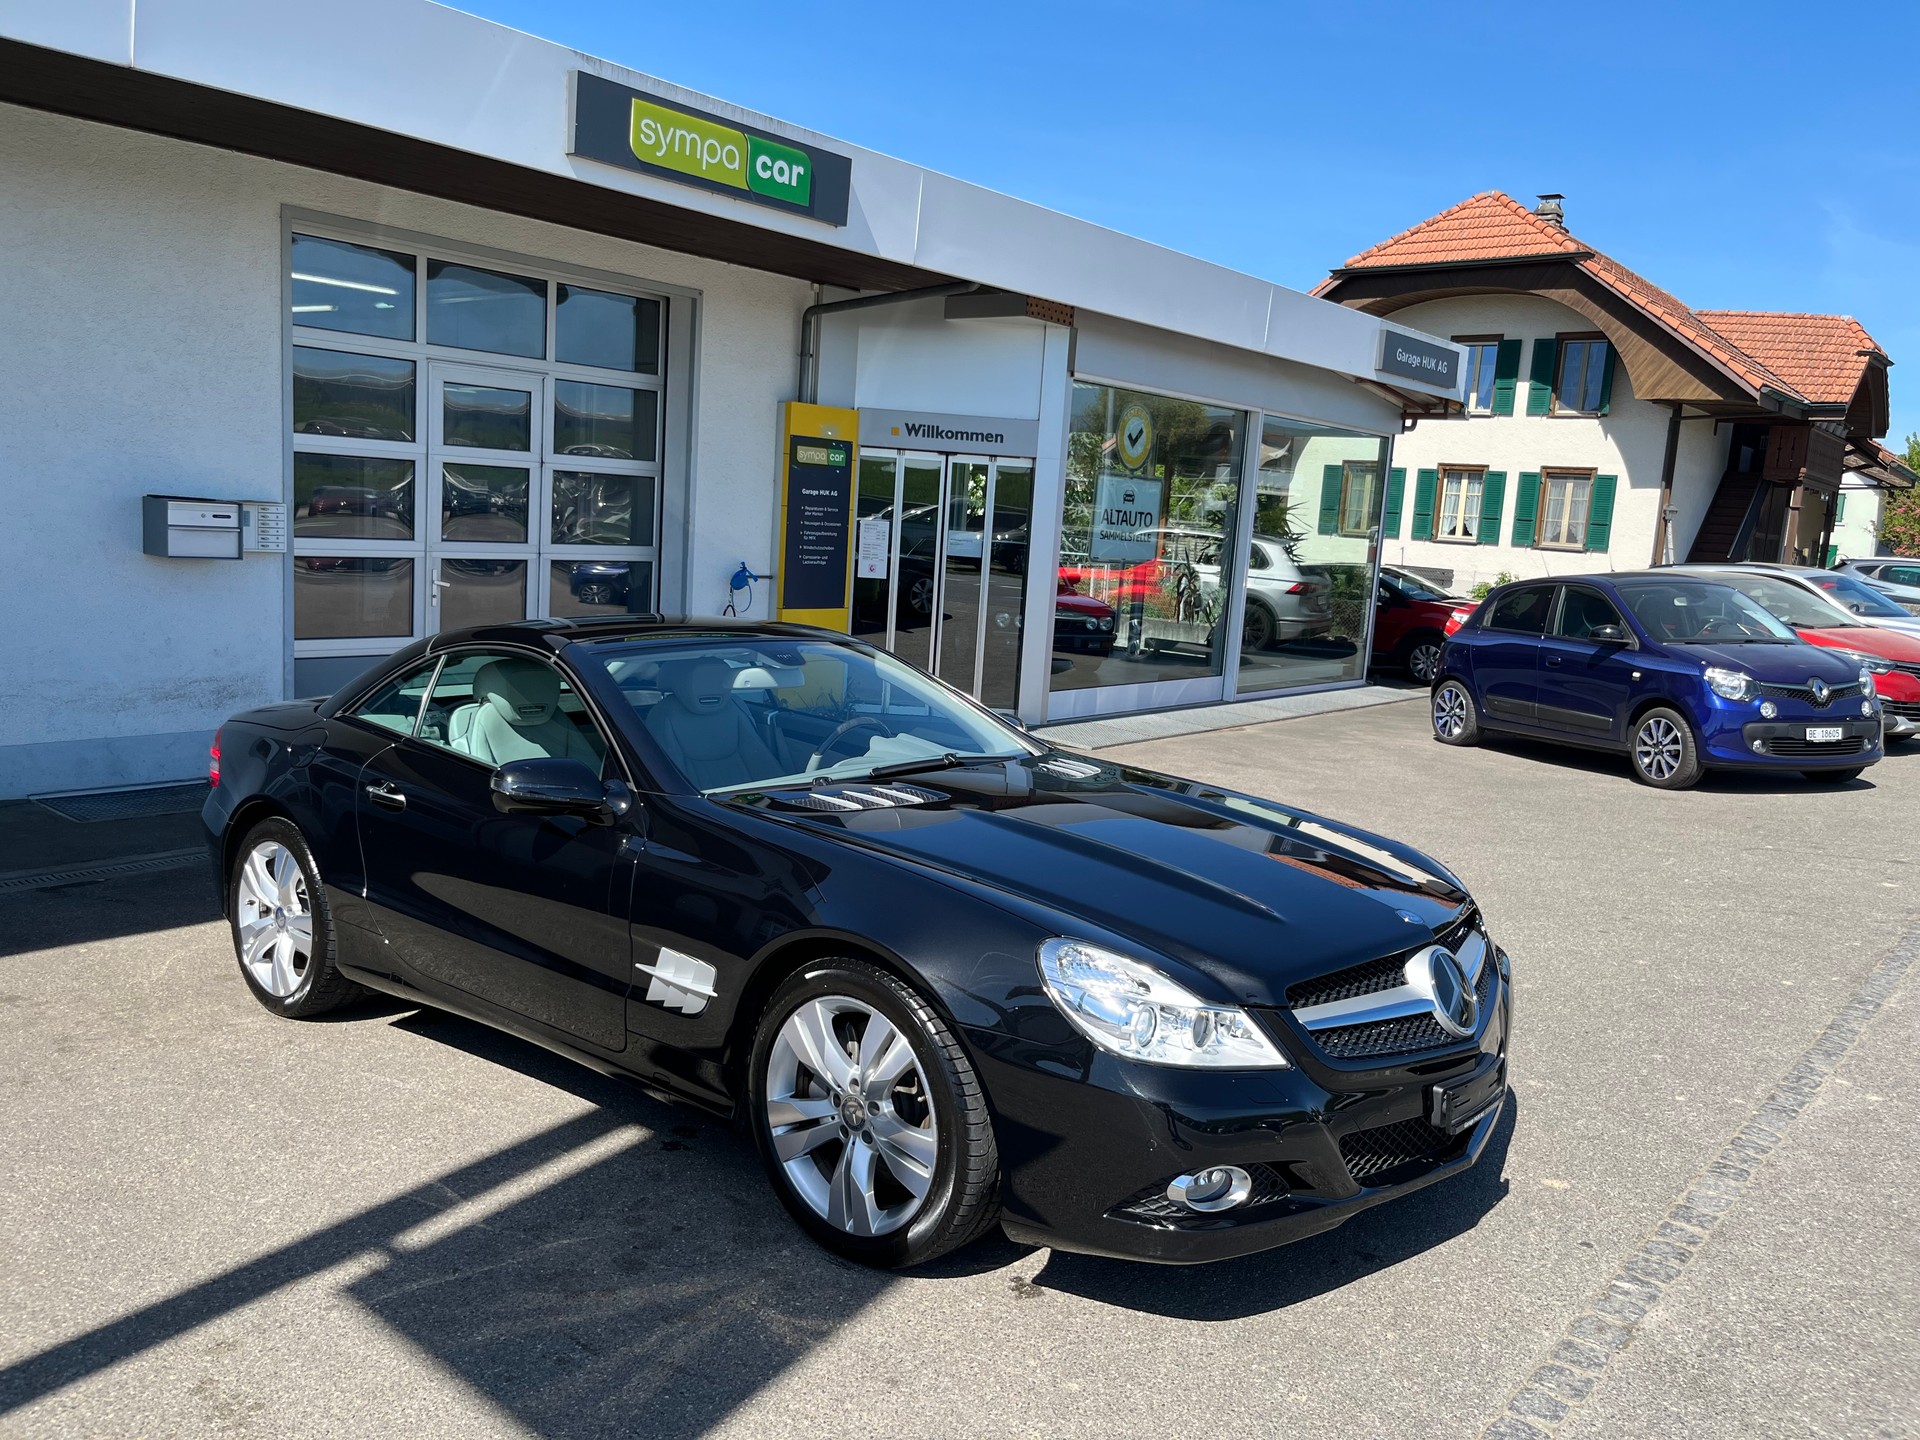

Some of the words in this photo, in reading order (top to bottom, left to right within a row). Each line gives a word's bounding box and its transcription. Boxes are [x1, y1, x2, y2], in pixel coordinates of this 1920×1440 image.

[640, 119, 740, 170] sympa
[755, 155, 804, 187] car
[1396, 348, 1420, 367] Garage
[1422, 356, 1436, 370] HUK
[1437, 361, 1448, 373] AG
[904, 422, 1004, 443] Willkommen
[799, 450, 826, 461] sympa
[830, 453, 844, 462] car
[801, 488, 819, 496] Garage
[1100, 508, 1153, 528] ALTAUTO
[1099, 530, 1152, 543] SAMMELSTELLE
[1808, 729, 1817, 738] BE
[1821, 729, 1839, 738] 18605
